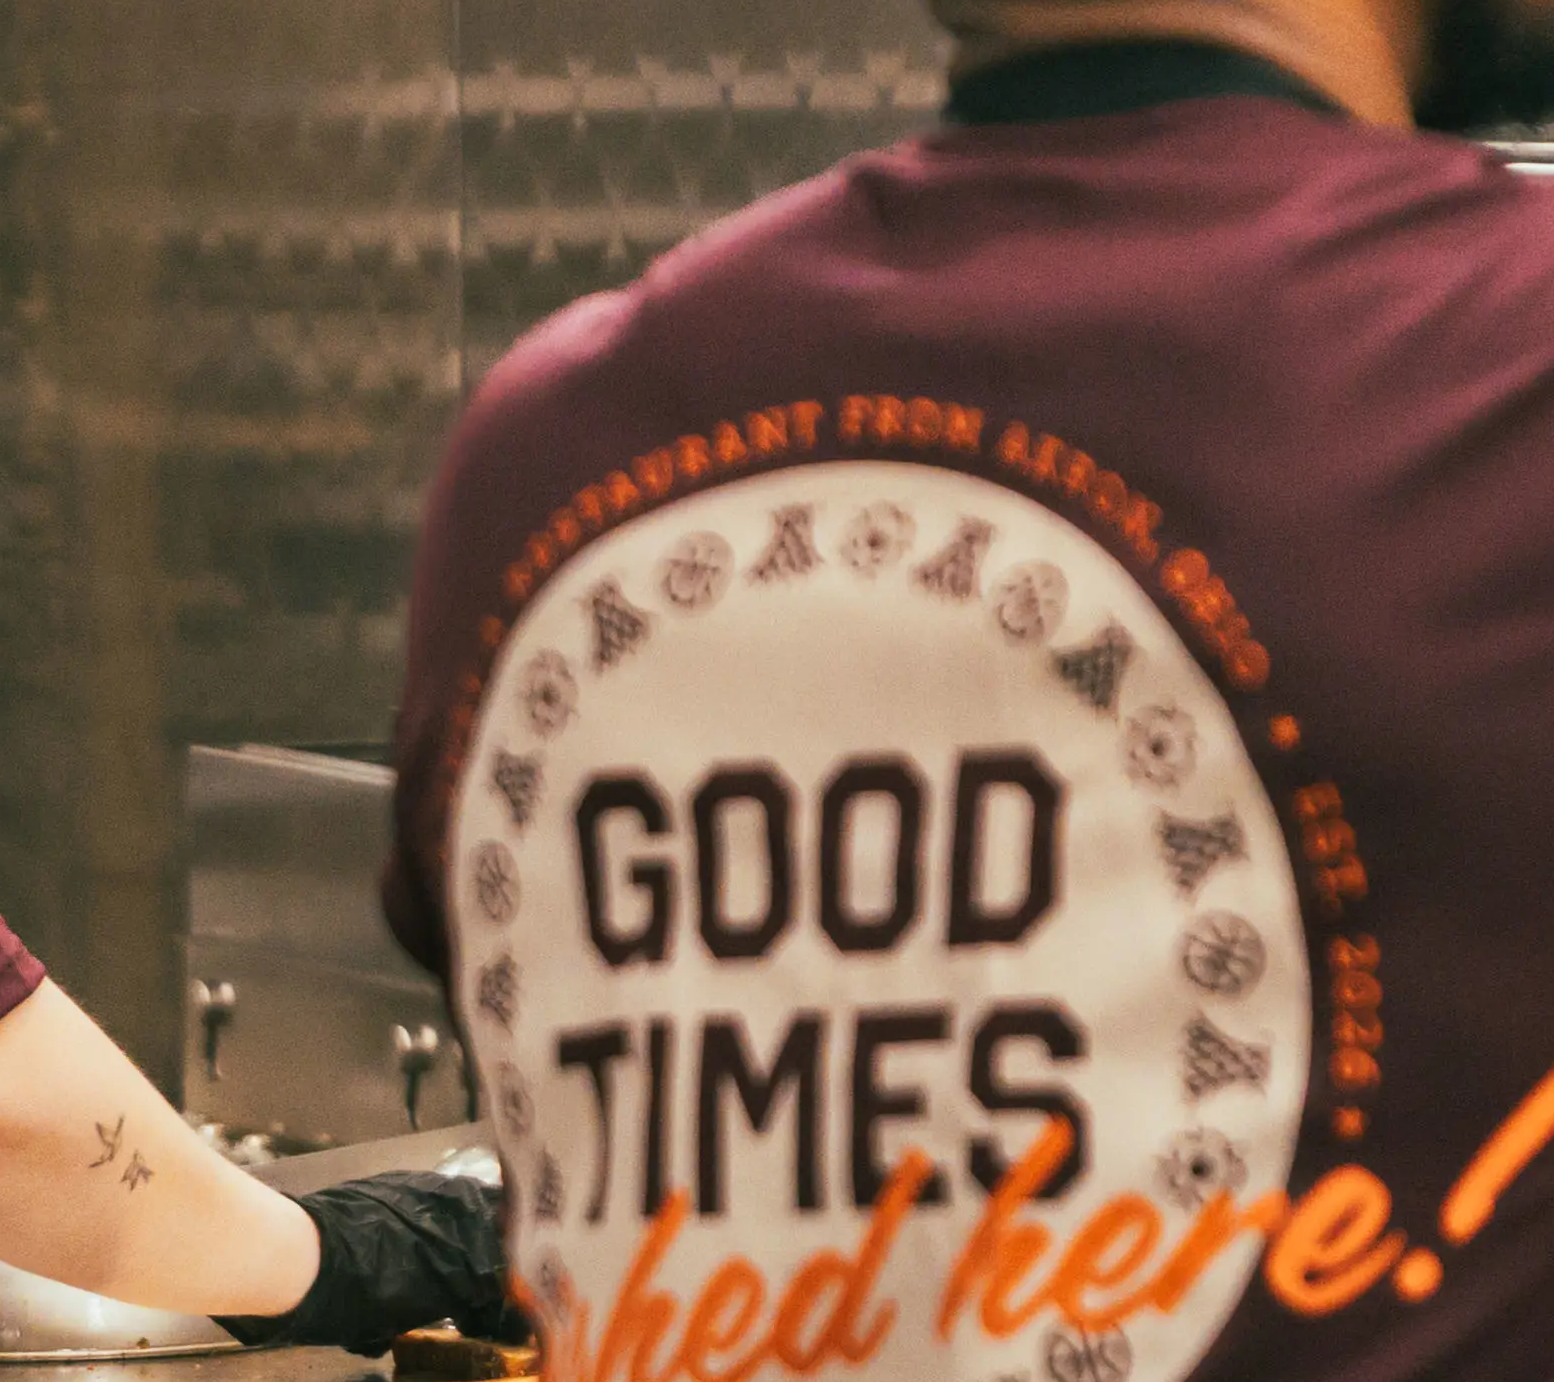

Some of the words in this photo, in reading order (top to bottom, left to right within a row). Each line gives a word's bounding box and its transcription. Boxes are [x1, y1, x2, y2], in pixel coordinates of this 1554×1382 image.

[838, 394, 986, 451] FROM
[574, 747, 1069, 967] GOOD
[553, 998, 1091, 1225] TIMES
